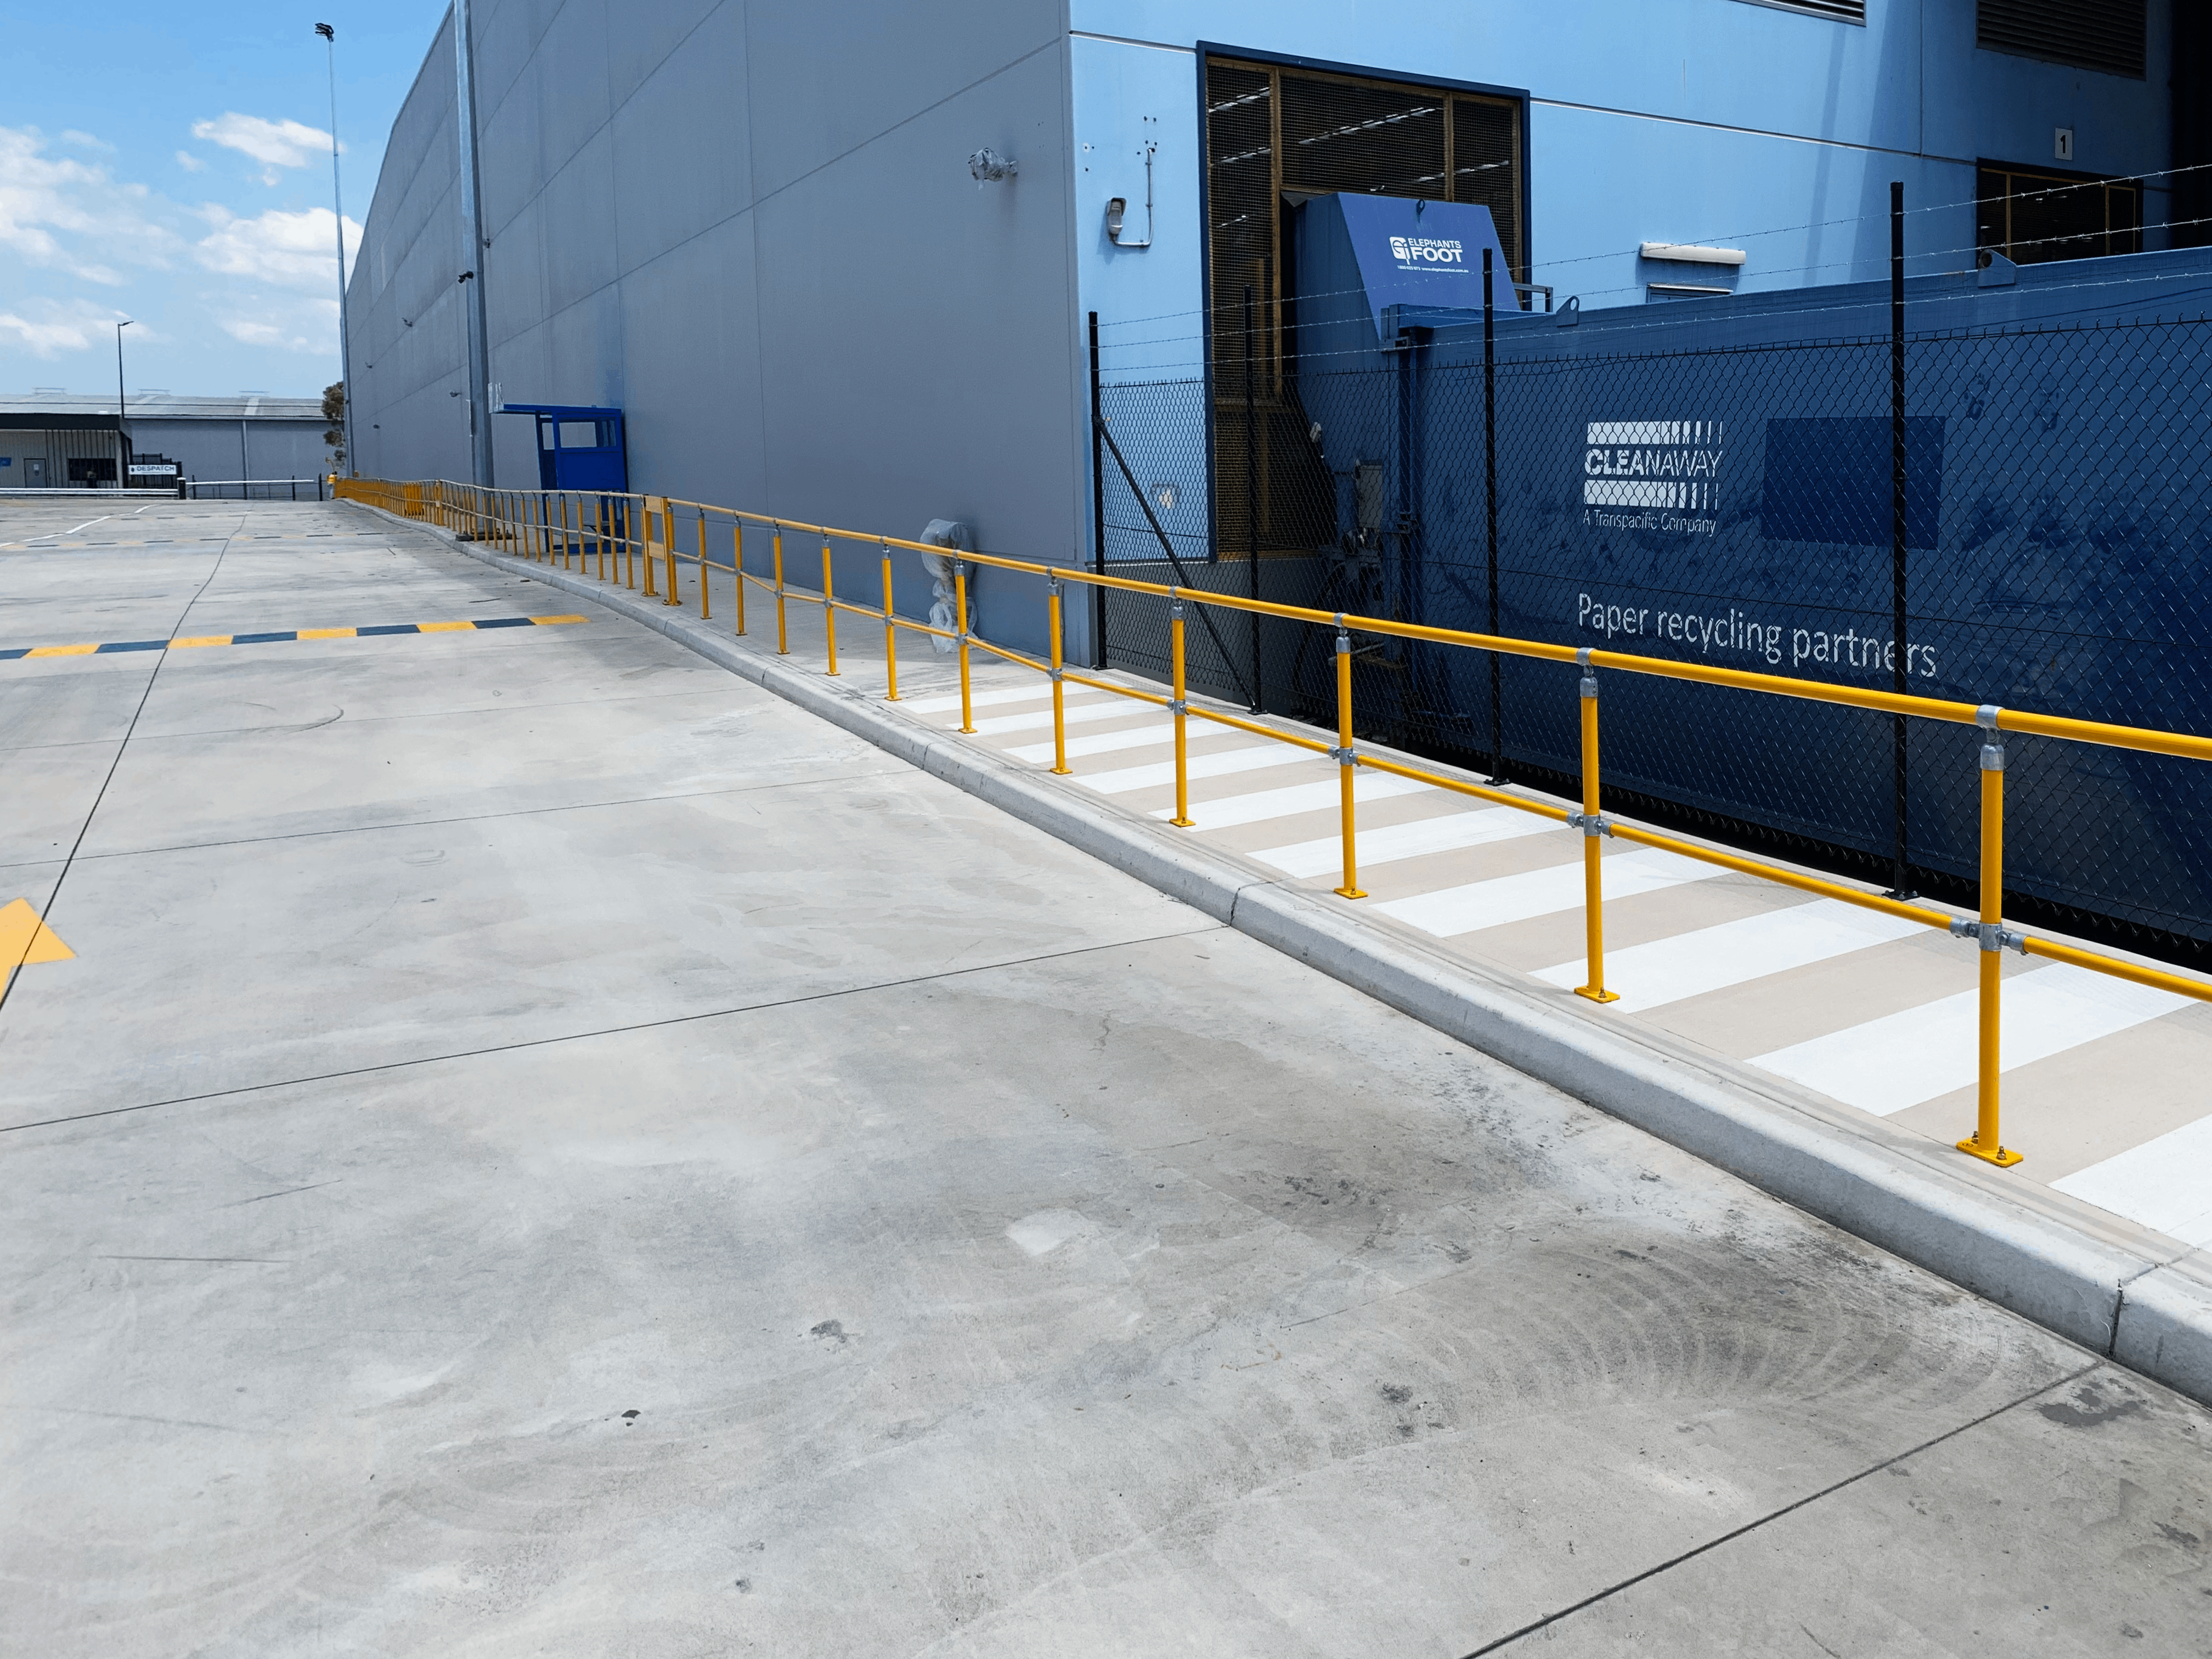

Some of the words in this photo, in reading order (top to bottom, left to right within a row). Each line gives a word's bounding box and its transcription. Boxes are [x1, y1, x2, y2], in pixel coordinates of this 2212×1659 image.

[2059, 134, 2066, 154] 1
[1408, 238, 1462, 249] ELEPHANTS
[1410, 247, 1463, 262] FOOT
[1584, 449, 1723, 477] CLEANAWAY
[1583, 509, 1590, 526] A
[1594, 509, 1657, 531] Transpacific
[1661, 512, 1717, 537] Company
[1579, 593, 1649, 639] Paper
[1658, 608, 1782, 664] recycling
[1793, 628, 1937, 678] partners
